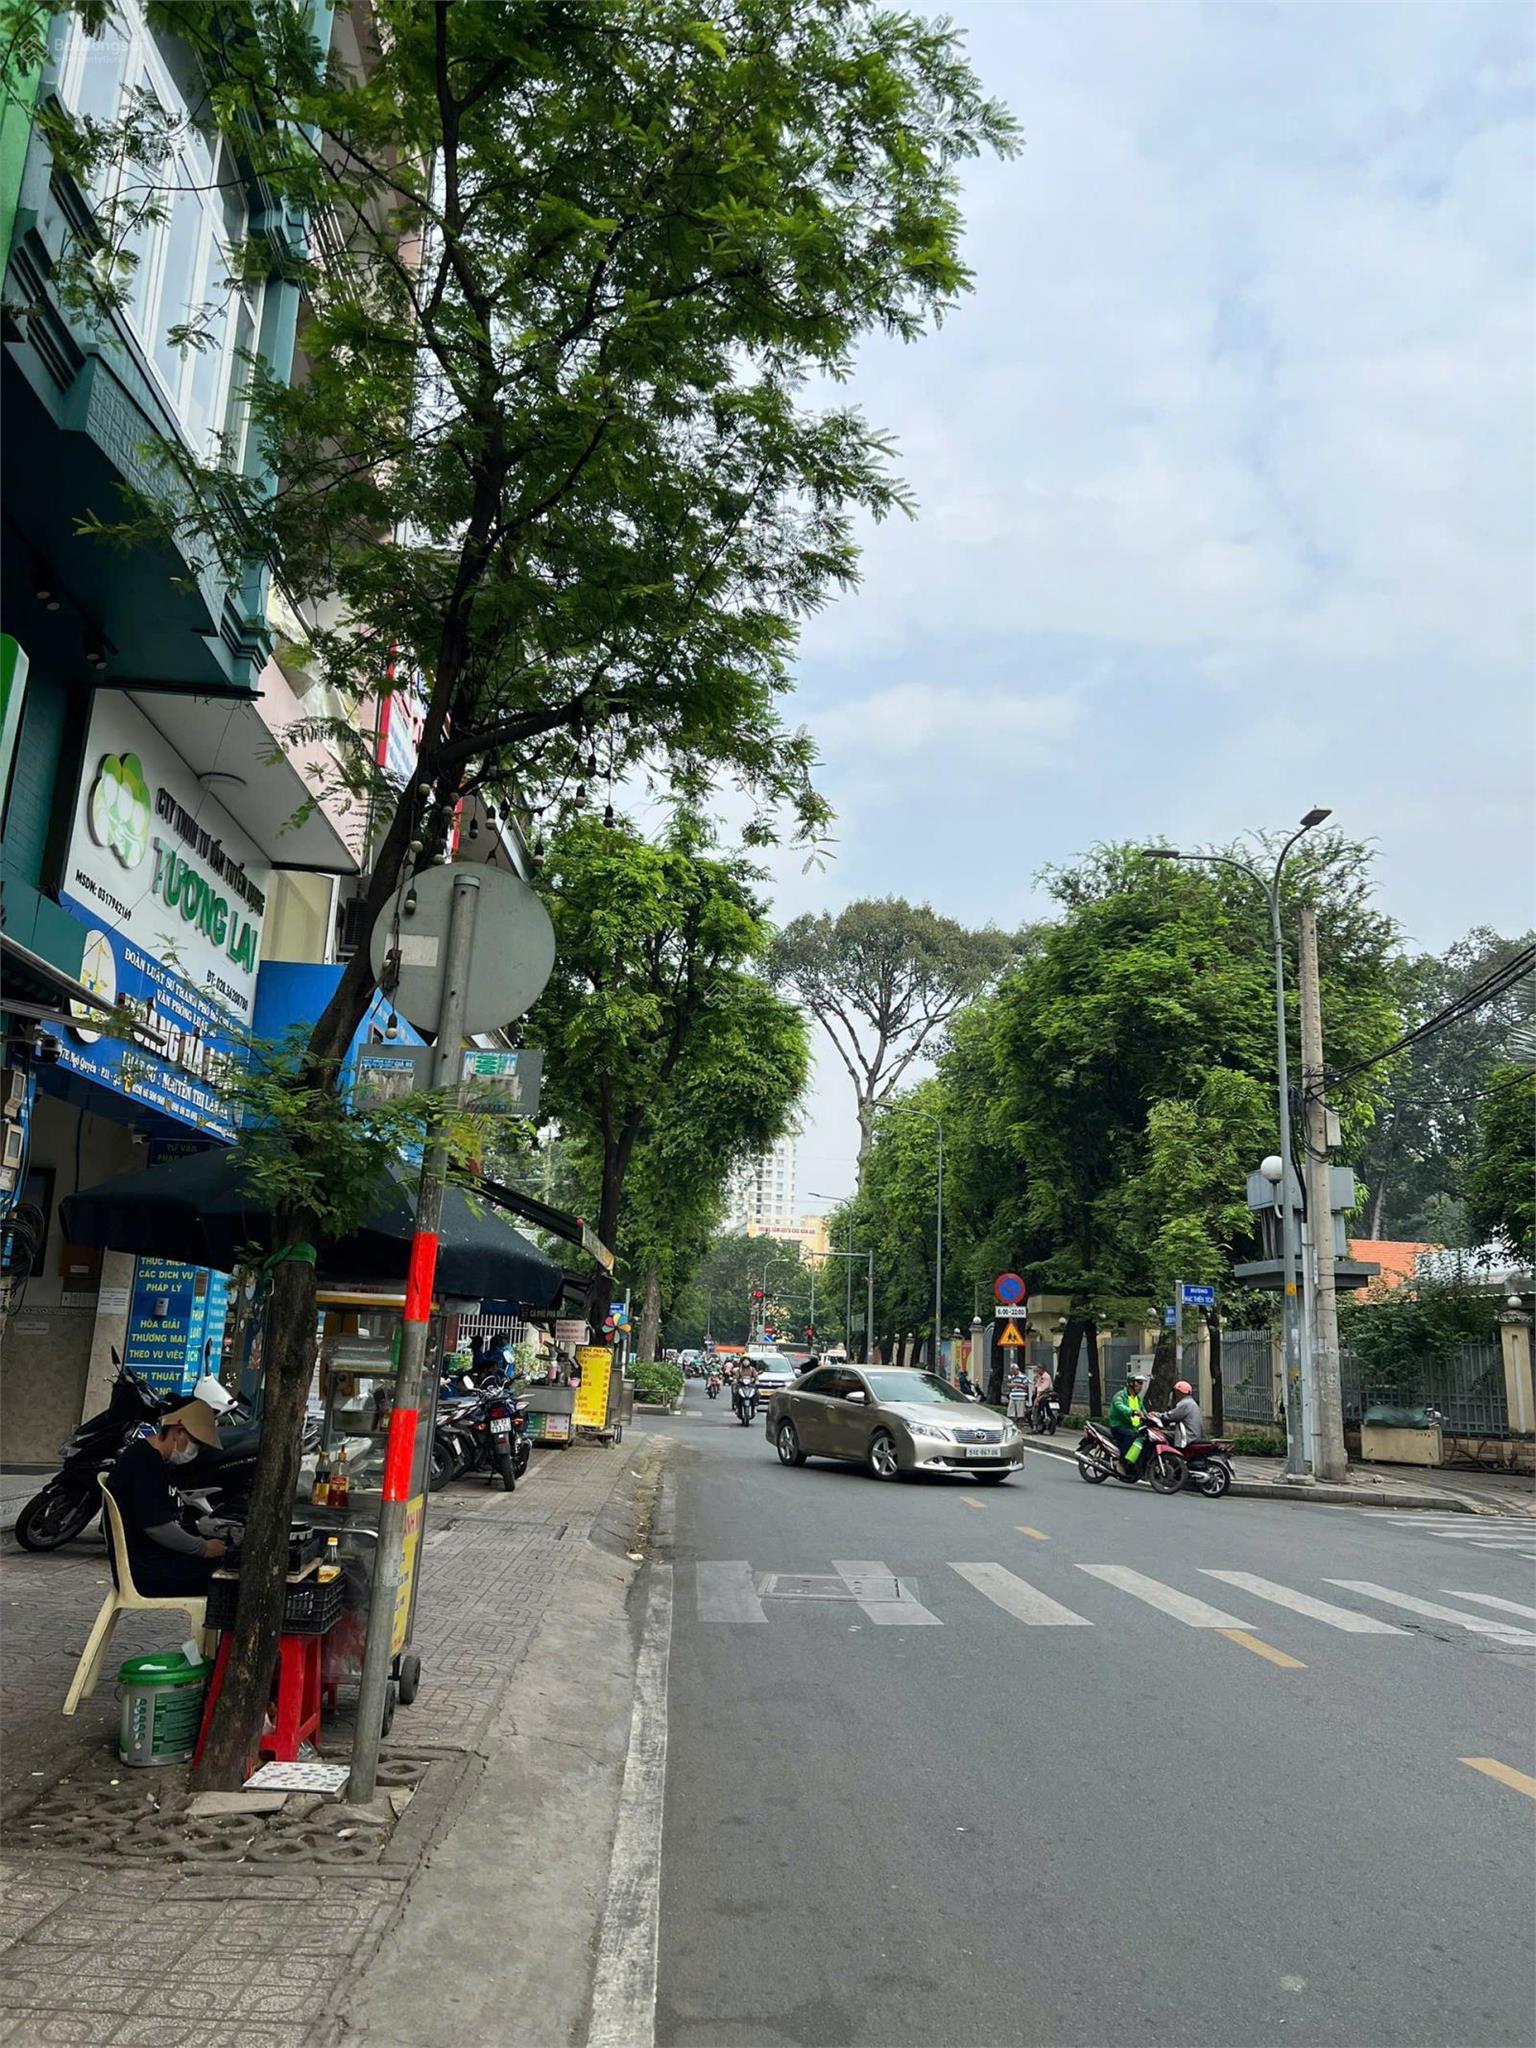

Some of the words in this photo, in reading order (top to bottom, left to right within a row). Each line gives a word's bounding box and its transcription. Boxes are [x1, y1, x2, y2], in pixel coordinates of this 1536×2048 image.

[155, 787, 177, 825] CTY
[173, 803, 200, 850] TNHH
[75, 868, 98, 896] MSDN:
[151, 836, 228, 947] TƯƠNG
[226, 910, 258, 975] LAI
[124, 947, 146, 972] ĐOÀN
[146, 960, 166, 987] LUẬT
[165, 976, 177, 992] SƯ
[156, 988, 171, 1008] VĂN
[171, 998, 192, 1022] PHÒNG
[192, 1088, 205, 1110] THỊ
[145, 1282, 169, 1293] PHÁP
[171, 1283, 182, 1294] LÝ
[140, 1319, 158, 1329] HÒA
[131, 1332, 168, 1343] THƯƠNG
[129, 1349, 151, 1359] THEO
